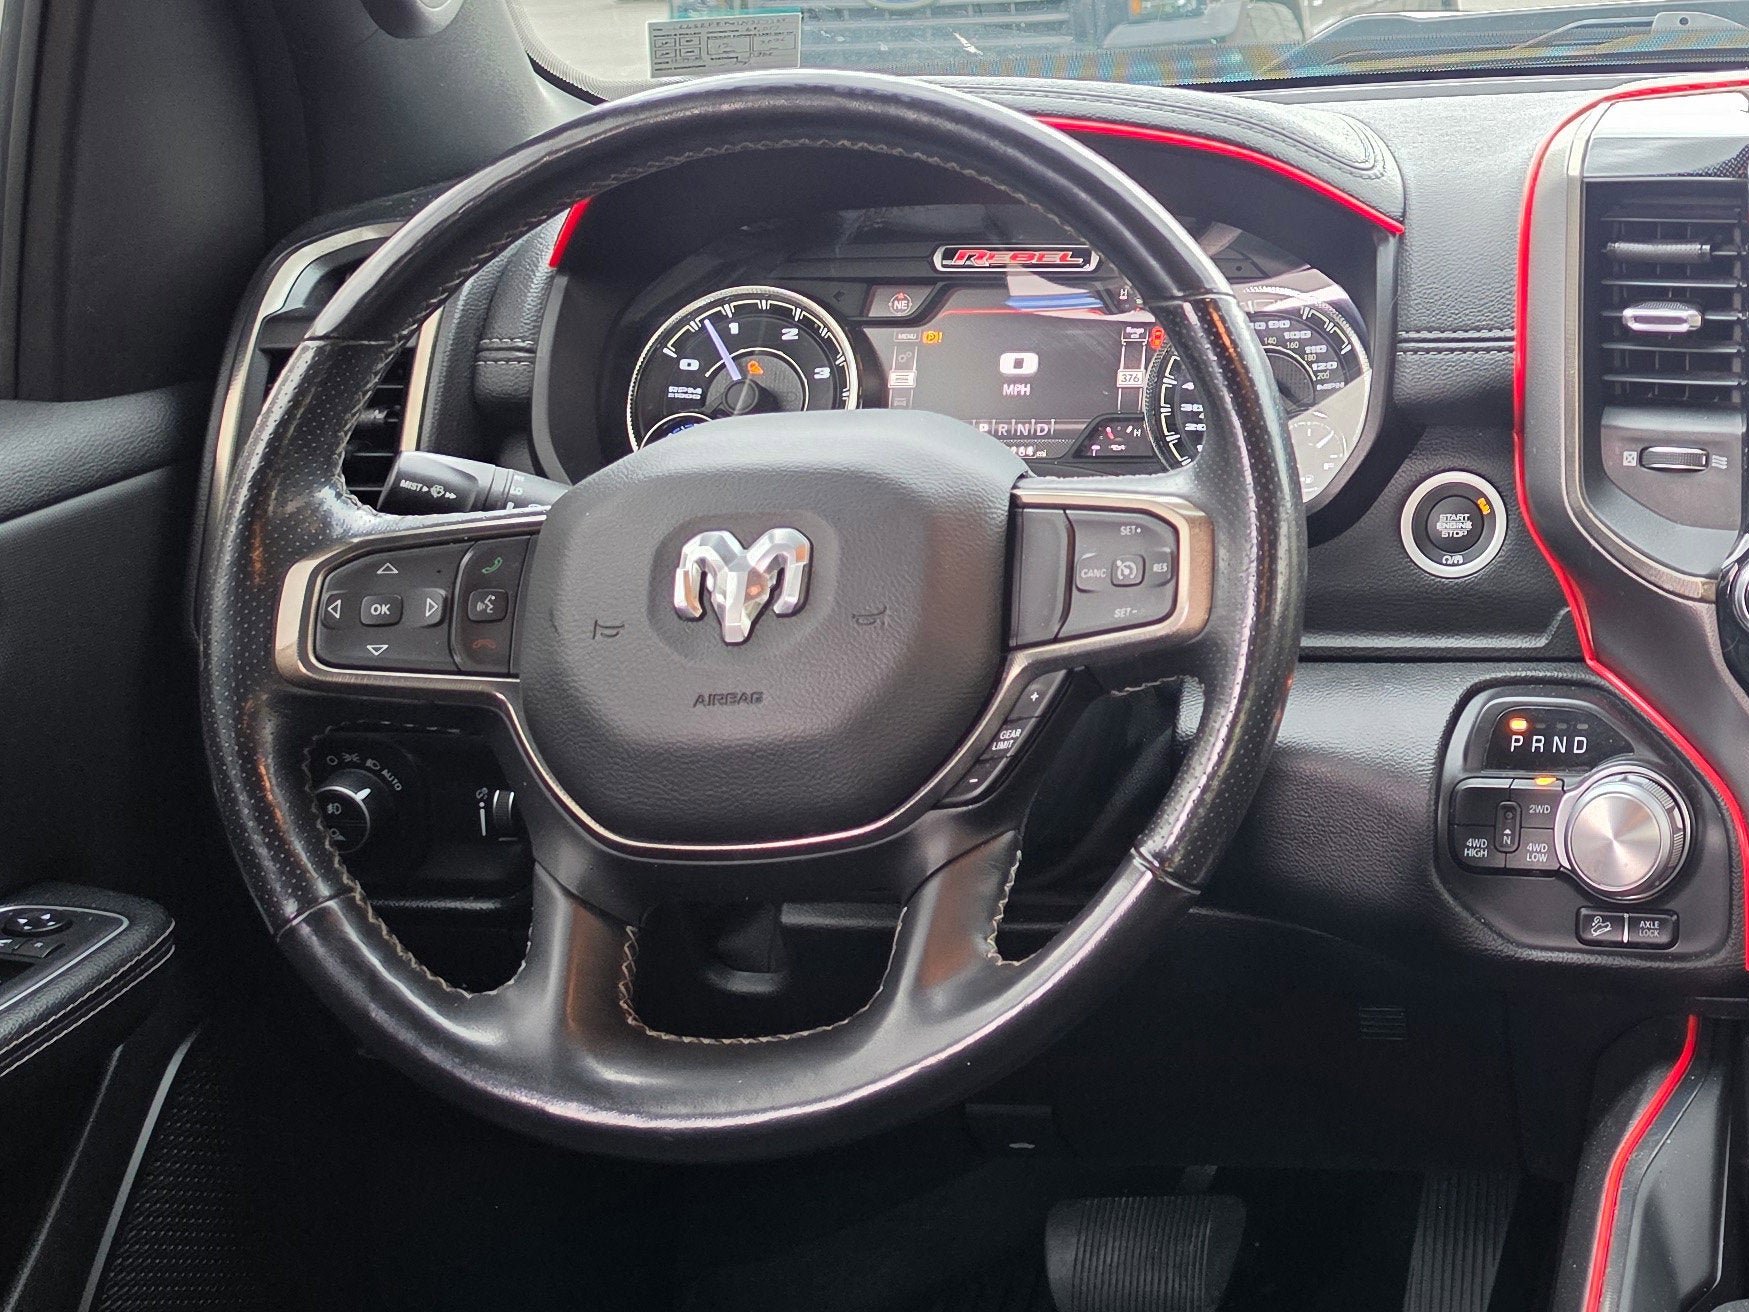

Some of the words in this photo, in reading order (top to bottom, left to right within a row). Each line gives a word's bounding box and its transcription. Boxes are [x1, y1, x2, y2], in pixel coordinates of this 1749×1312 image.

[952, 249, 1084, 266] REBEL
[894, 301, 908, 309] NE
[729, 322, 739, 334] 1
[782, 328, 799, 340] 2
[1264, 337, 1277, 345] 140
[1286, 341, 1299, 349] 160
[679, 359, 699, 370] 0
[1000, 353, 1038, 375] 0
[1312, 361, 1337, 370] 120
[814, 367, 830, 379] 3
[1121, 374, 1140, 383] 376
[668, 386, 702, 394] RPM
[1003, 384, 1031, 395] MPH
[999, 424, 1008, 436] R
[1017, 424, 1029, 436] N
[1037, 424, 1049, 436] D
[400, 479, 423, 492] MIST
[1440, 514, 1470, 522] START
[1437, 521, 1472, 530] ENGINE
[1441, 530, 1468, 538] STOP
[1153, 563, 1168, 572] RES
[1081, 569, 1107, 578] CANC
[371, 604, 390, 615] OK
[693, 692, 763, 708] AIRBAG
[1000, 729, 1021, 739] GEAR
[992, 740, 1014, 751] LIMIT
[1511, 735, 1523, 752] P
[1531, 736, 1545, 753] R
[1552, 737, 1567, 753] N
[1573, 737, 1587, 754] D
[381, 769, 403, 791] AUTO
[1529, 805, 1550, 814] 2WD
[1466, 839, 1488, 848] 4WD
[1503, 836, 1511, 845] N
[1526, 843, 1548, 853] 4WD
[1464, 848, 1488, 858] HIGH
[1526, 853, 1548, 862] LOW
[1639, 921, 1660, 929] AXLE
[1639, 929, 1660, 938] LOCK
